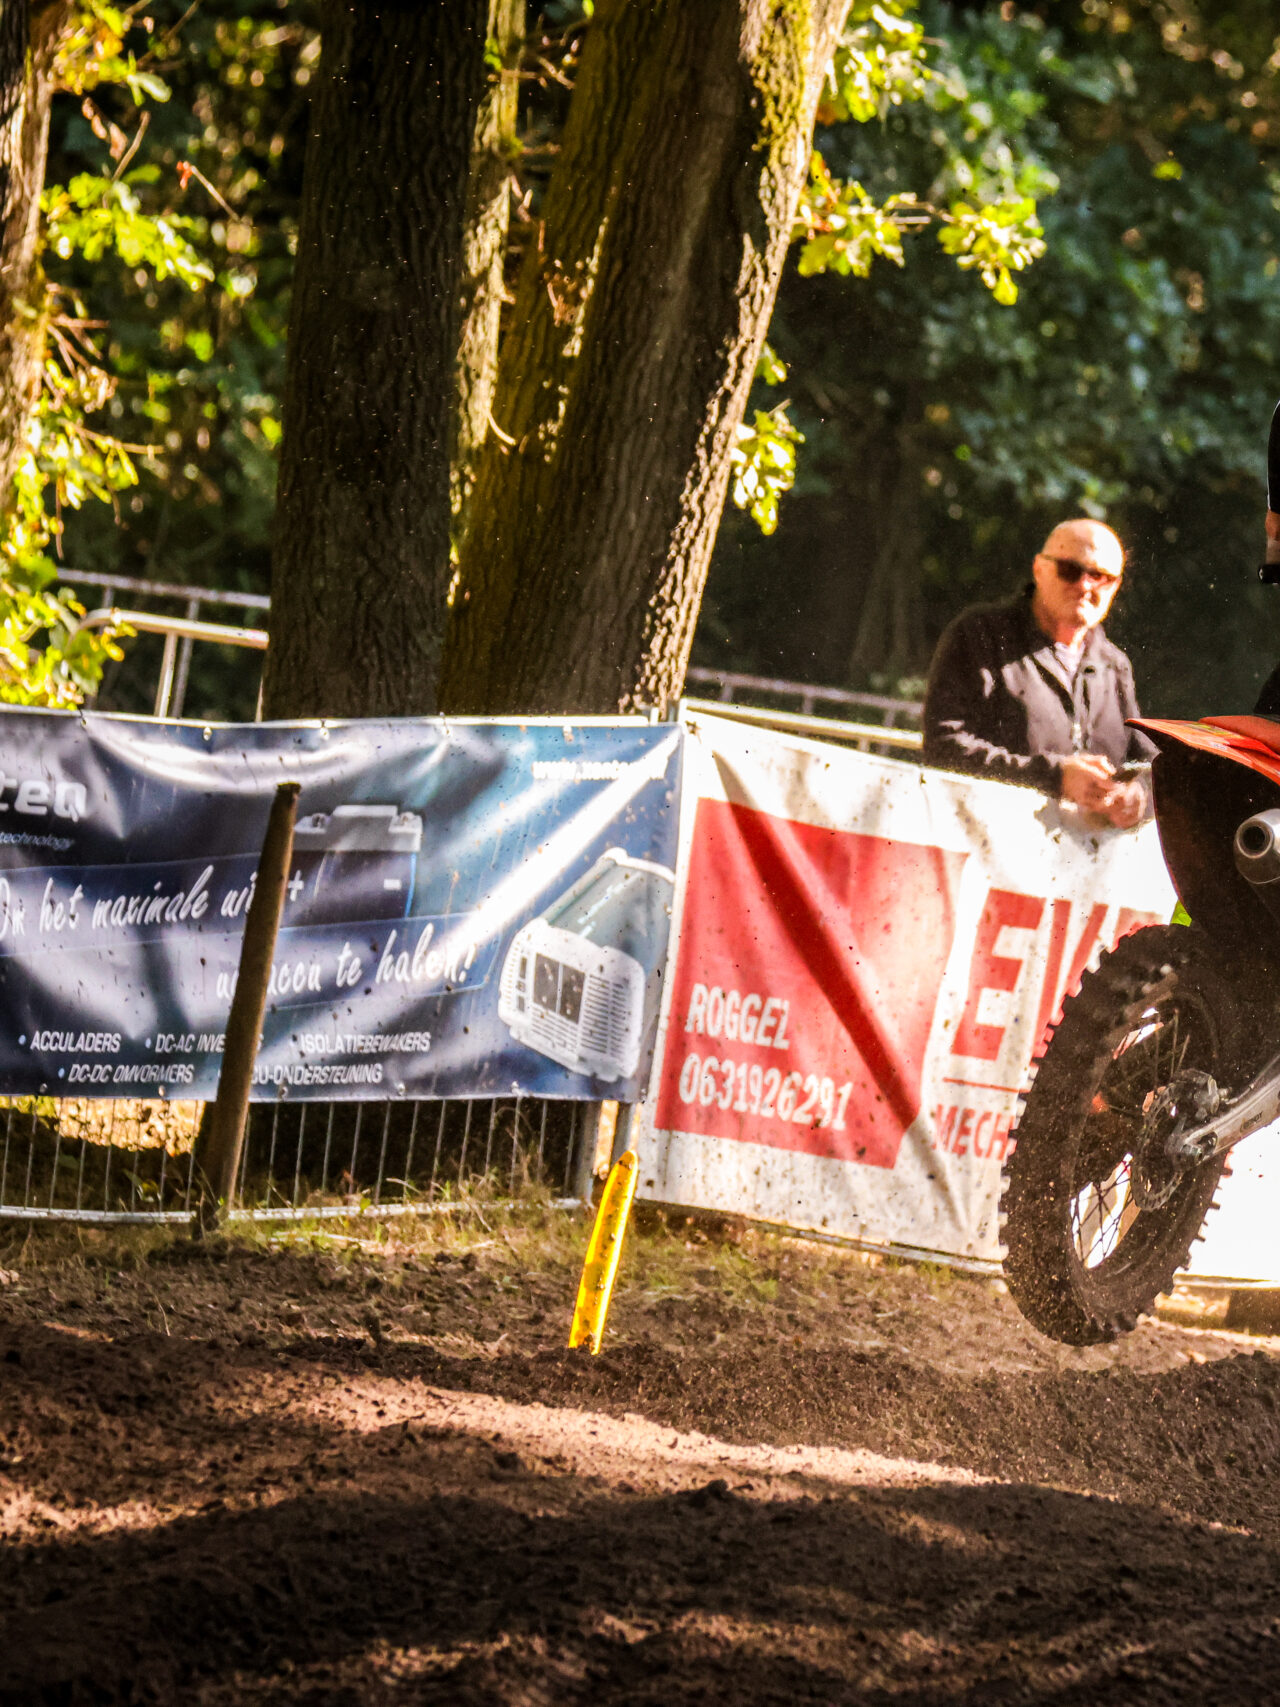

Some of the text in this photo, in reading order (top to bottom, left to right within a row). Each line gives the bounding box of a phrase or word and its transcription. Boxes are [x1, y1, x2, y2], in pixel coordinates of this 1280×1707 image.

[39, 877, 84, 935] het
[92, 864, 214, 930] maximale
[221, 871, 257, 918] ui
[336, 941, 362, 988] te
[30, 1030, 122, 1053] ACCULADERS
[155, 1033, 195, 1053] DC-AC
[299, 1032, 432, 1054] ISOLATIEBEWAKERS
[68, 1063, 195, 1084] DC-DC OMVORMERS
[679, 1053, 853, 1131] 0631926291
[932, 1103, 1017, 1160] MECH
